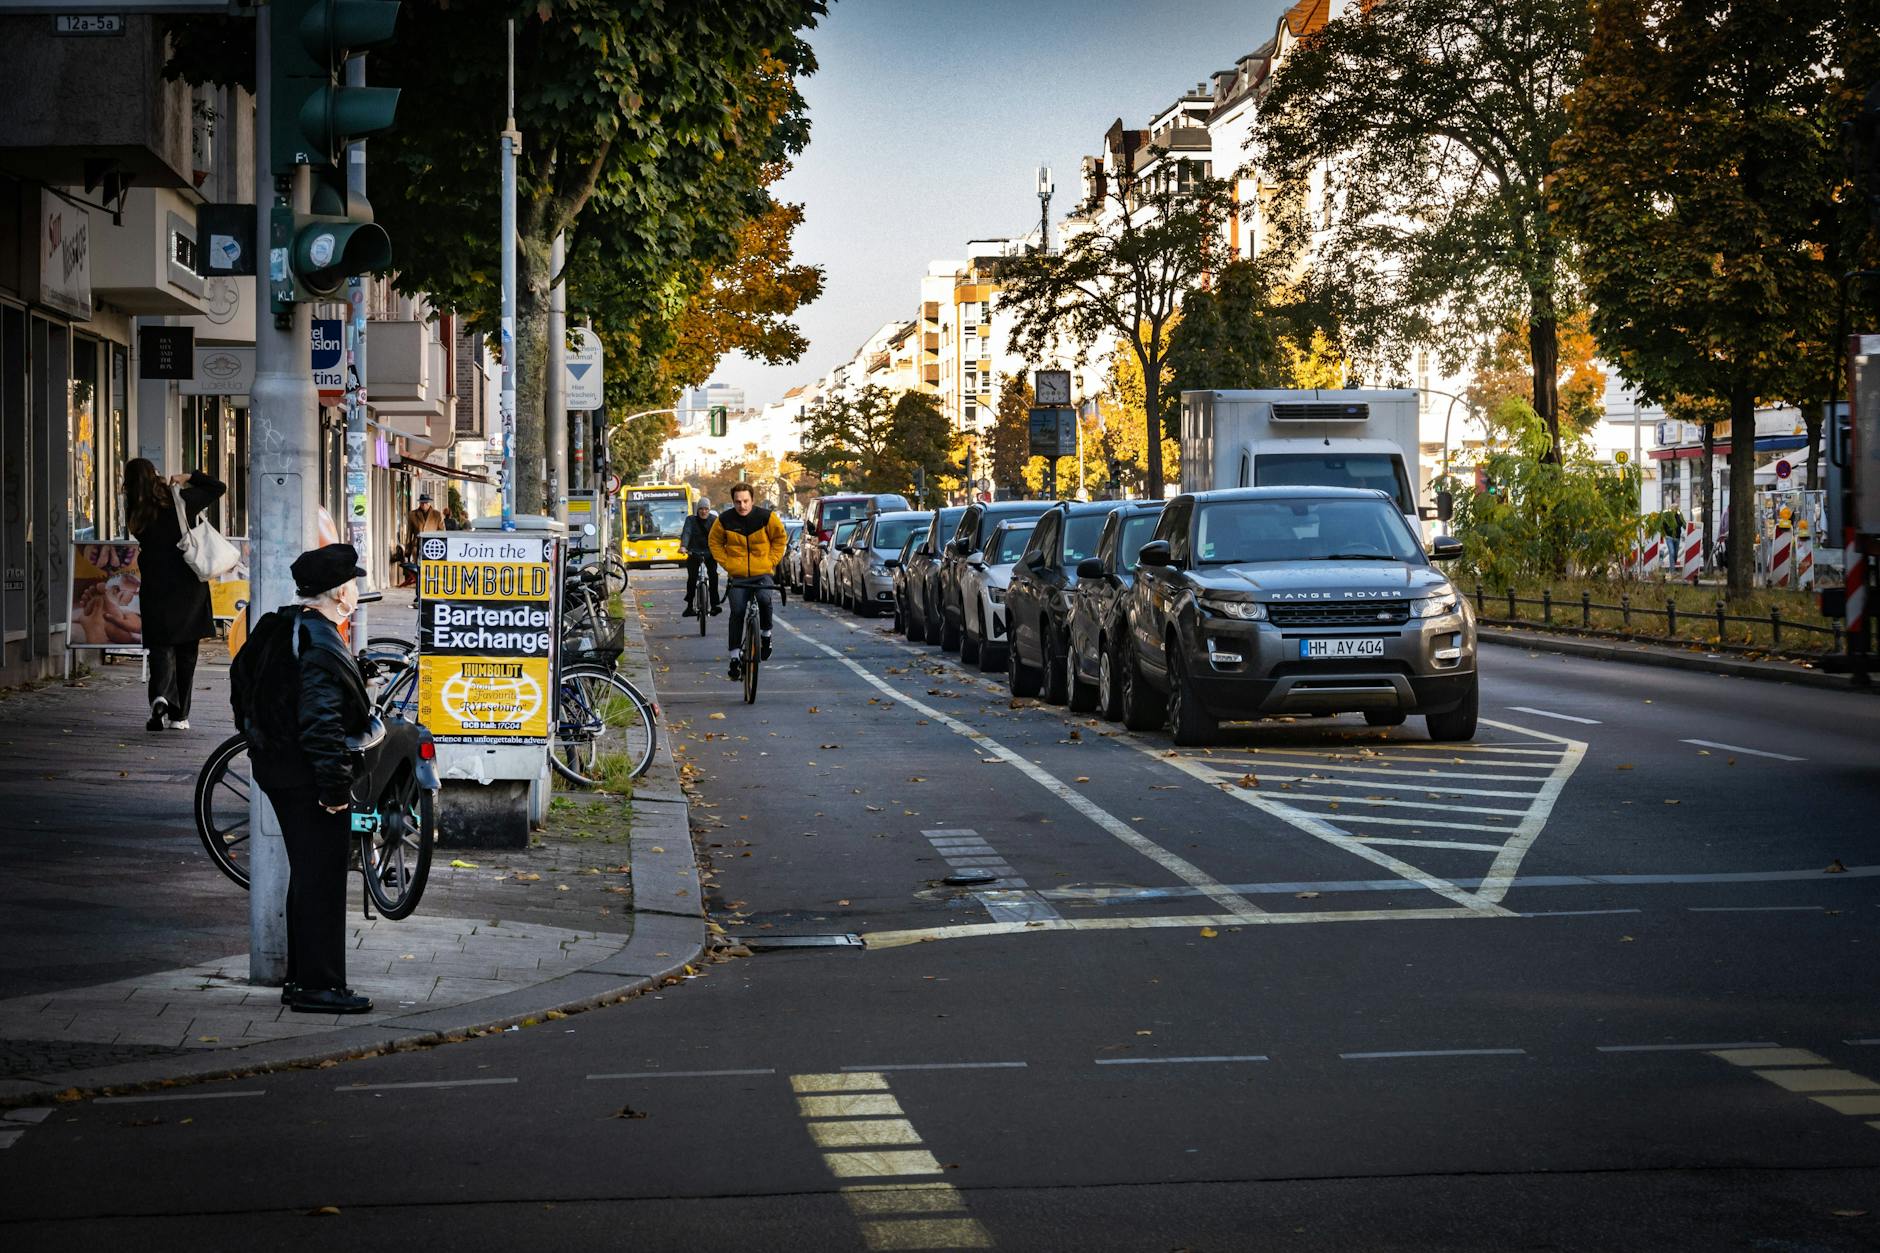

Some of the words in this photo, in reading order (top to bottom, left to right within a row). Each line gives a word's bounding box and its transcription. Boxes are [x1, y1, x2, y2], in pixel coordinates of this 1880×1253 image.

[66, 16, 113, 30] 12a-5a
[295, 153, 309, 164] F1
[278, 290, 294, 301] KL1
[311, 327, 324, 339] el
[459, 542, 495, 558] Join
[499, 543, 526, 559] the
[424, 564, 549, 597] HUMBOLD
[1271, 592, 1332, 600] RANGE
[1343, 590, 1402, 599] ROVER
[433, 626, 550, 654] Exchange
[1308, 641, 1328, 655] HH
[1335, 640, 1355, 655] AY
[1357, 639, 1383, 654] 404
[463, 663, 521, 678] HUMBOLDT
[462, 721, 480, 730] BCB
[473, 735, 522, 745] unforgettable
